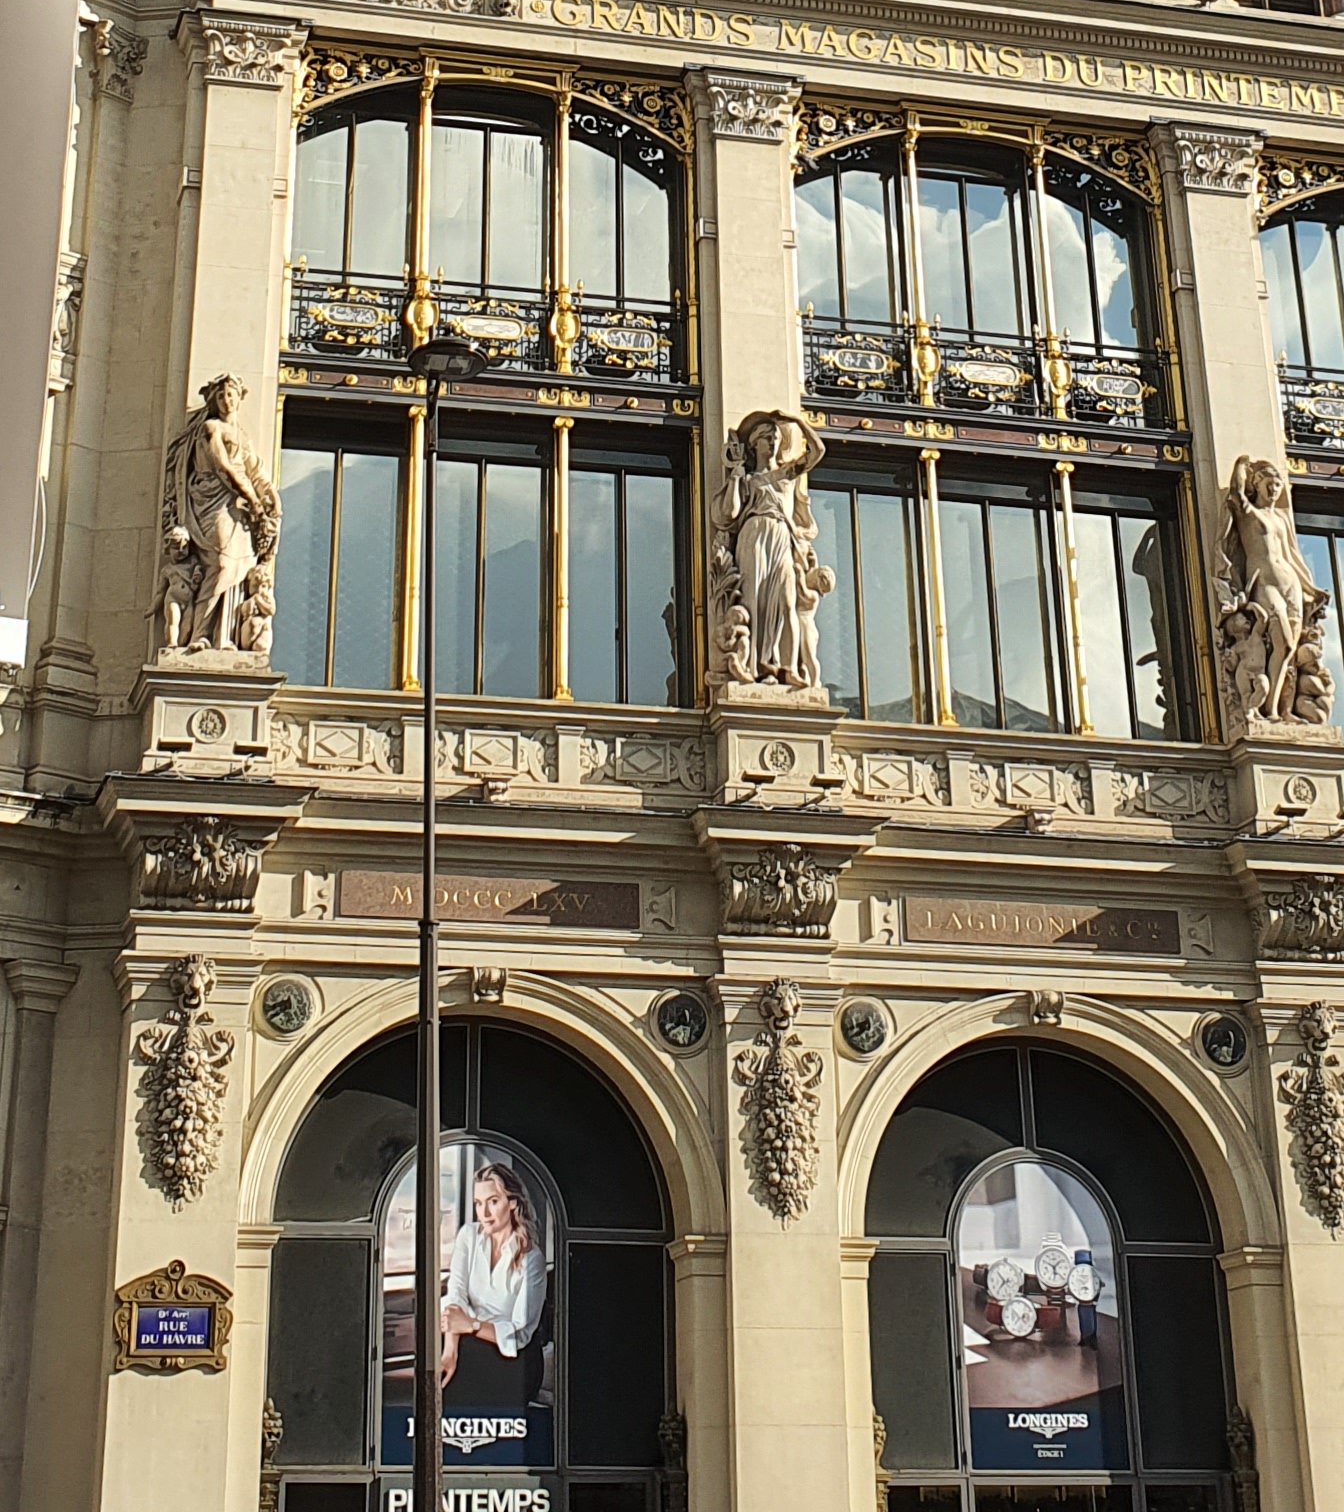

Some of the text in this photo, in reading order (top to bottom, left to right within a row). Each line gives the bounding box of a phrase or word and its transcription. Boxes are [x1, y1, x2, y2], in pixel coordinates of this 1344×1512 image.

[777, 19, 1025, 78] MAGASINS
[1042, 51, 1103, 86] DU
[531, 891, 591, 912] LXV
[924, 910, 1100, 937] LAGUIONIE
[159, 1321, 188, 1332] RUE
[140, 1334, 159, 1345] DU
[407, 1417, 527, 1438] LNGINES
[1007, 1413, 1089, 1428] LONGINES
